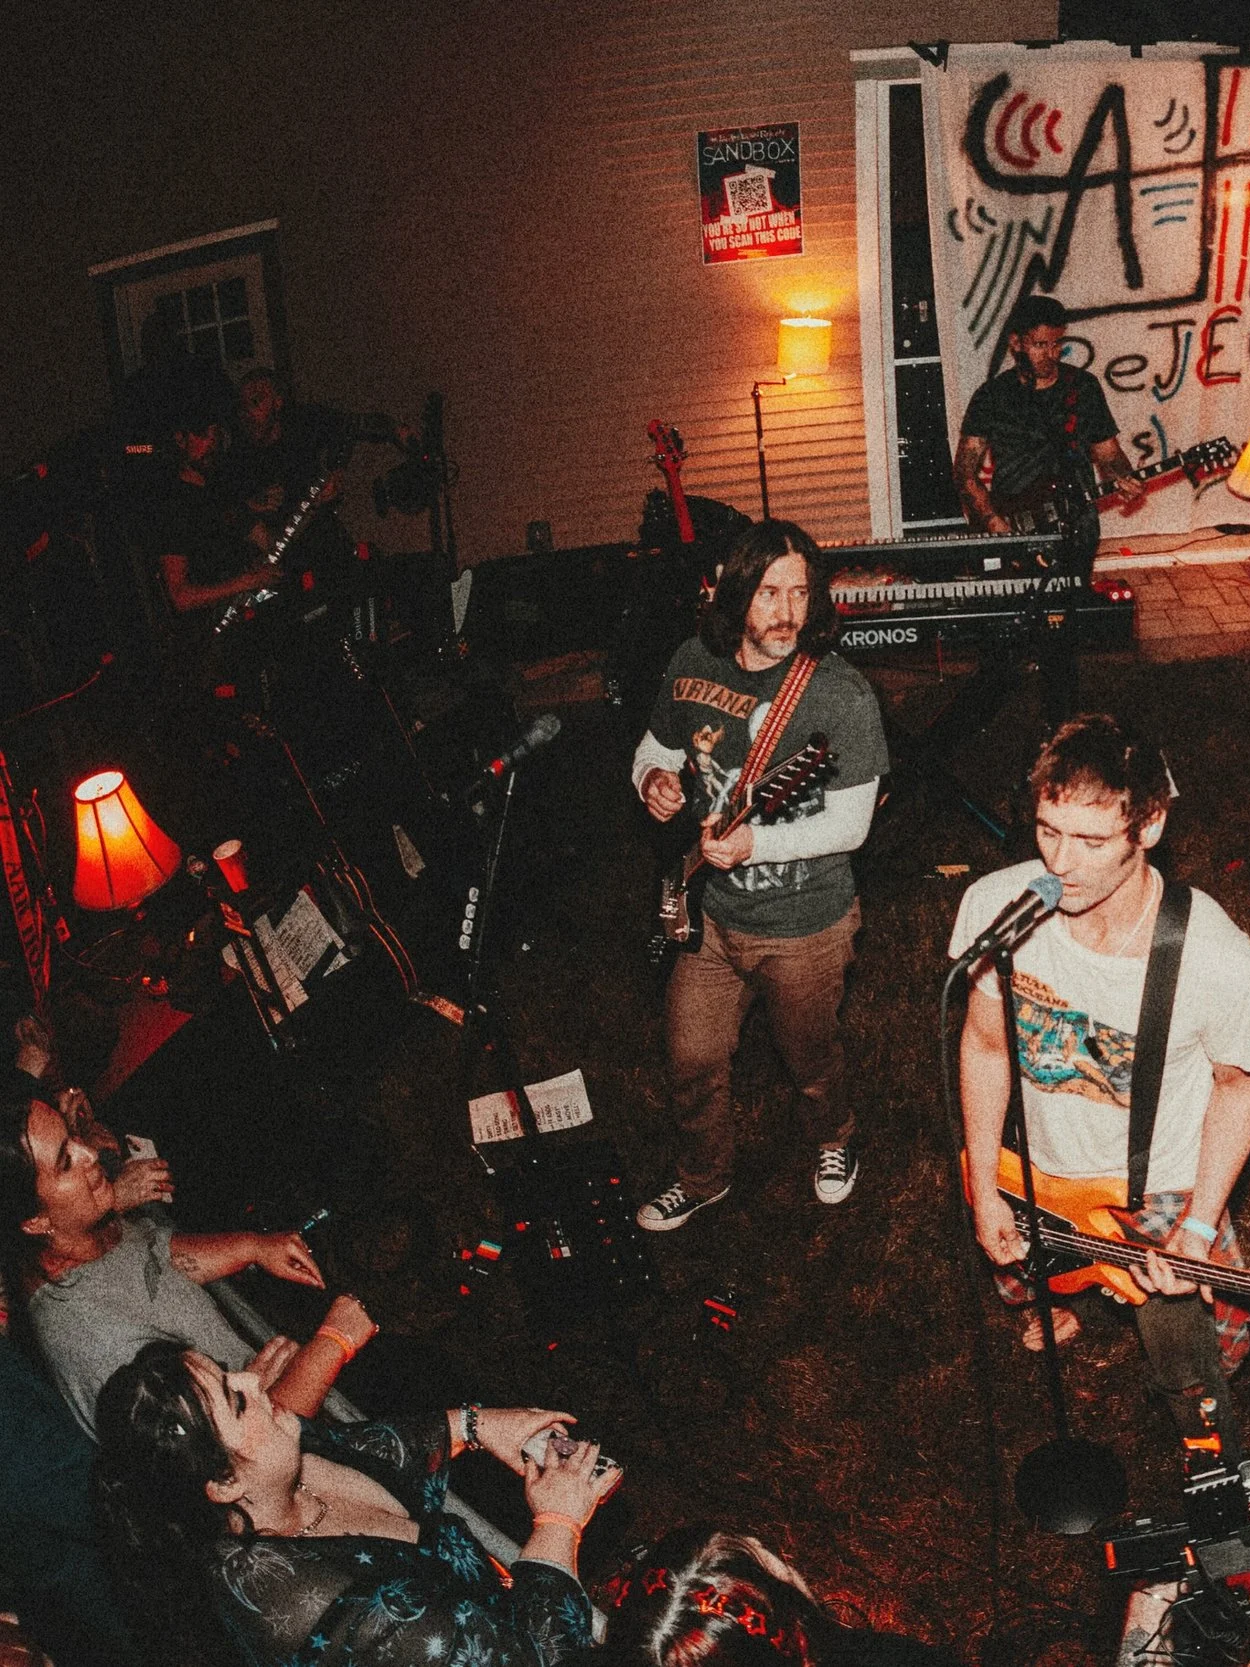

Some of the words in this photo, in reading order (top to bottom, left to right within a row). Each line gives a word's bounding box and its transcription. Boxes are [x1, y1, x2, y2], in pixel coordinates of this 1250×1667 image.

[702, 137, 795, 166] SANDBOX
[768, 211, 796, 229] WHEN
[709, 236, 728, 251] YOU
[729, 233, 753, 248] SCAN
[754, 230, 777, 244] THIS
[777, 226, 802, 242] CODE
[840, 627, 918, 647] KRONOS
